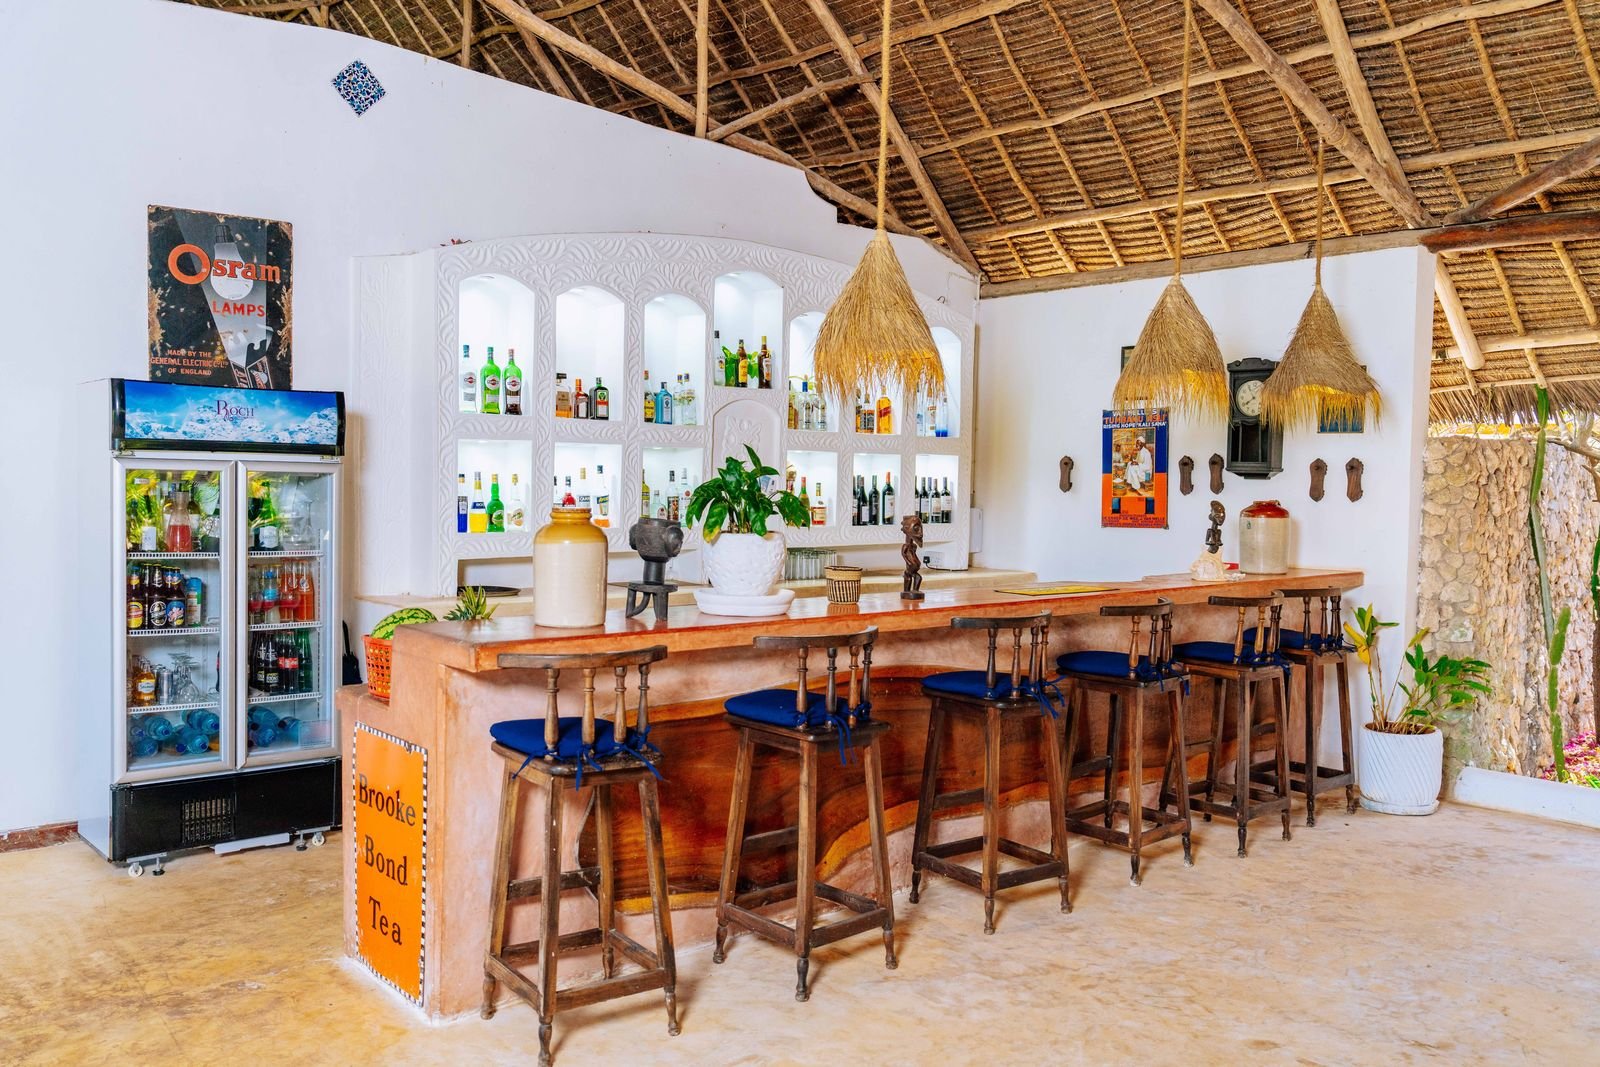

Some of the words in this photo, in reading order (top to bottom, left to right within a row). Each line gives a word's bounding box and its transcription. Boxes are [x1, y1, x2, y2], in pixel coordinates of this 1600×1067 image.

[168, 243, 282, 285] Osram
[213, 301, 266, 318] LAMPS
[150, 357, 181, 366] GENERAL
[182, 359, 213, 367] ELECTRIC
[180, 368, 212, 376] ENGLAND
[358, 773, 416, 827] Brooke
[364, 834, 408, 886] Bond
[368, 895, 402, 946] Tea
